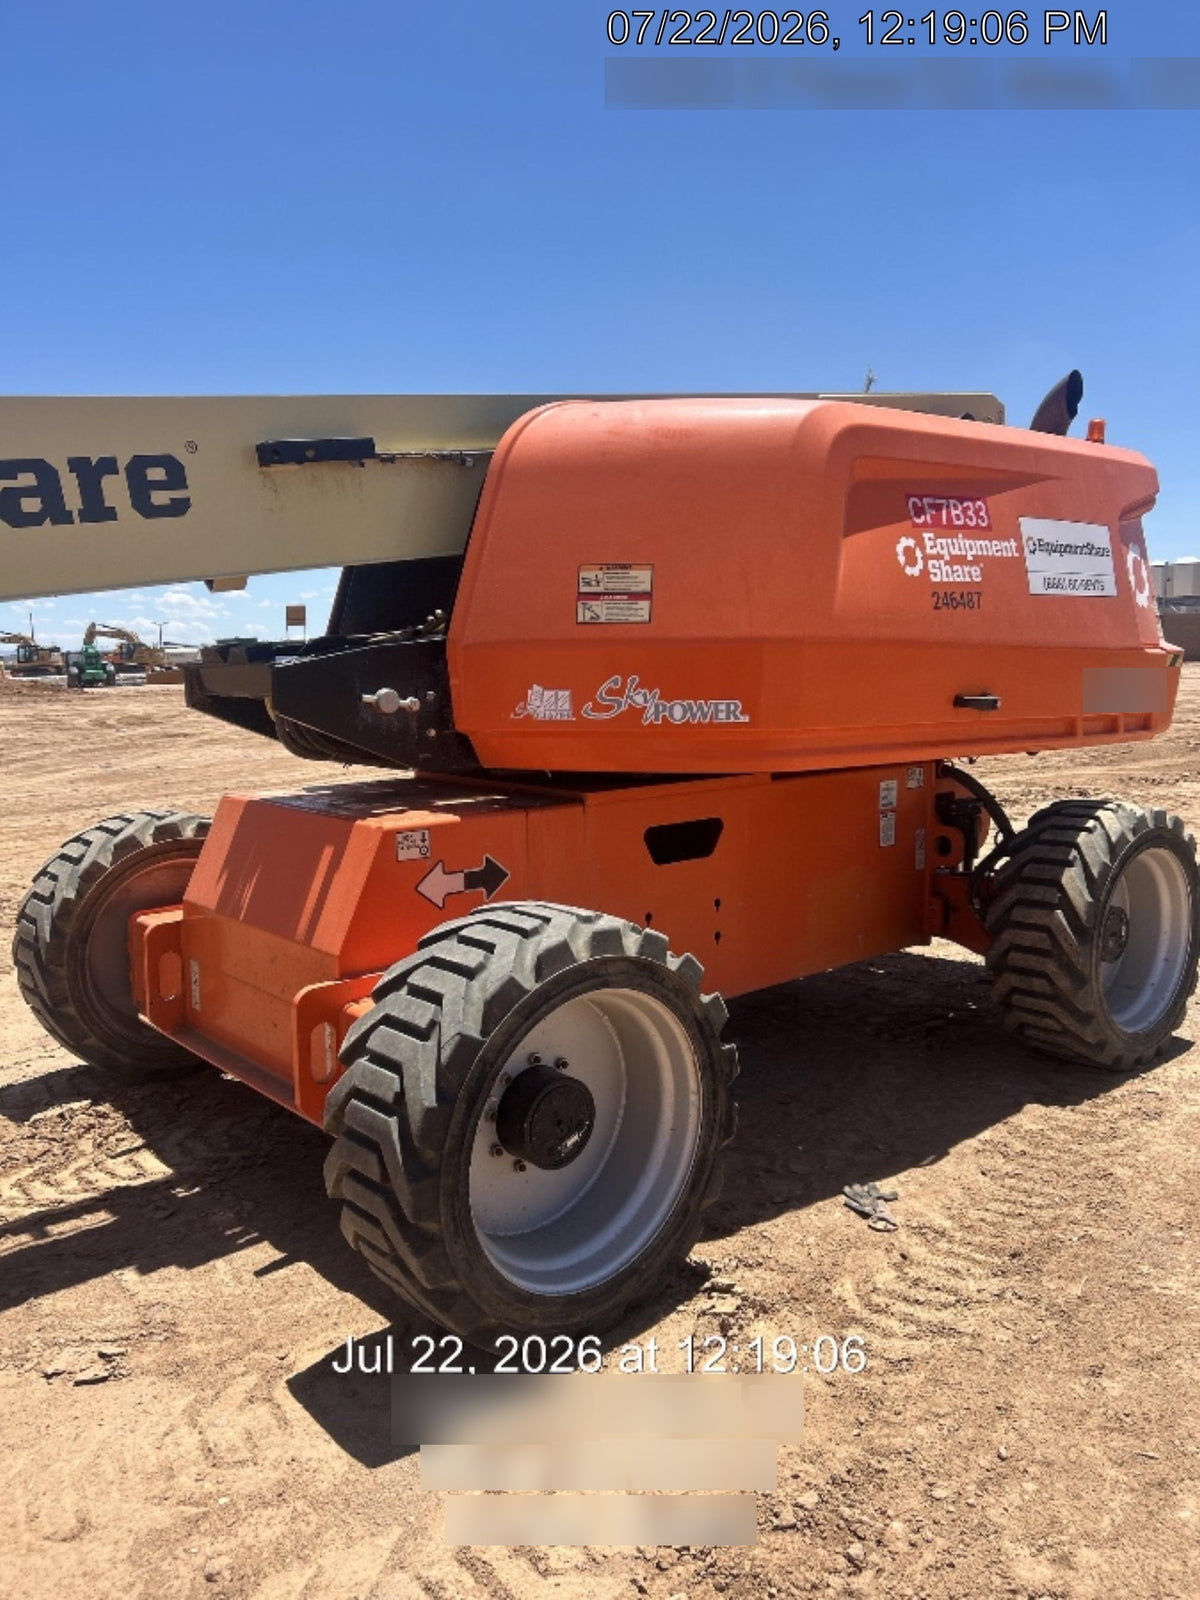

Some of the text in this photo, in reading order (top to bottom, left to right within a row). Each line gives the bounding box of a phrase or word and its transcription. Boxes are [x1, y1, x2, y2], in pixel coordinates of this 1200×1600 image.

[908, 496, 988, 527] CF7B33
[922, 532, 1020, 561] Equipment
[927, 560, 983, 583] Share
[931, 591, 982, 610] 246487
[581, 675, 660, 725] Sky
